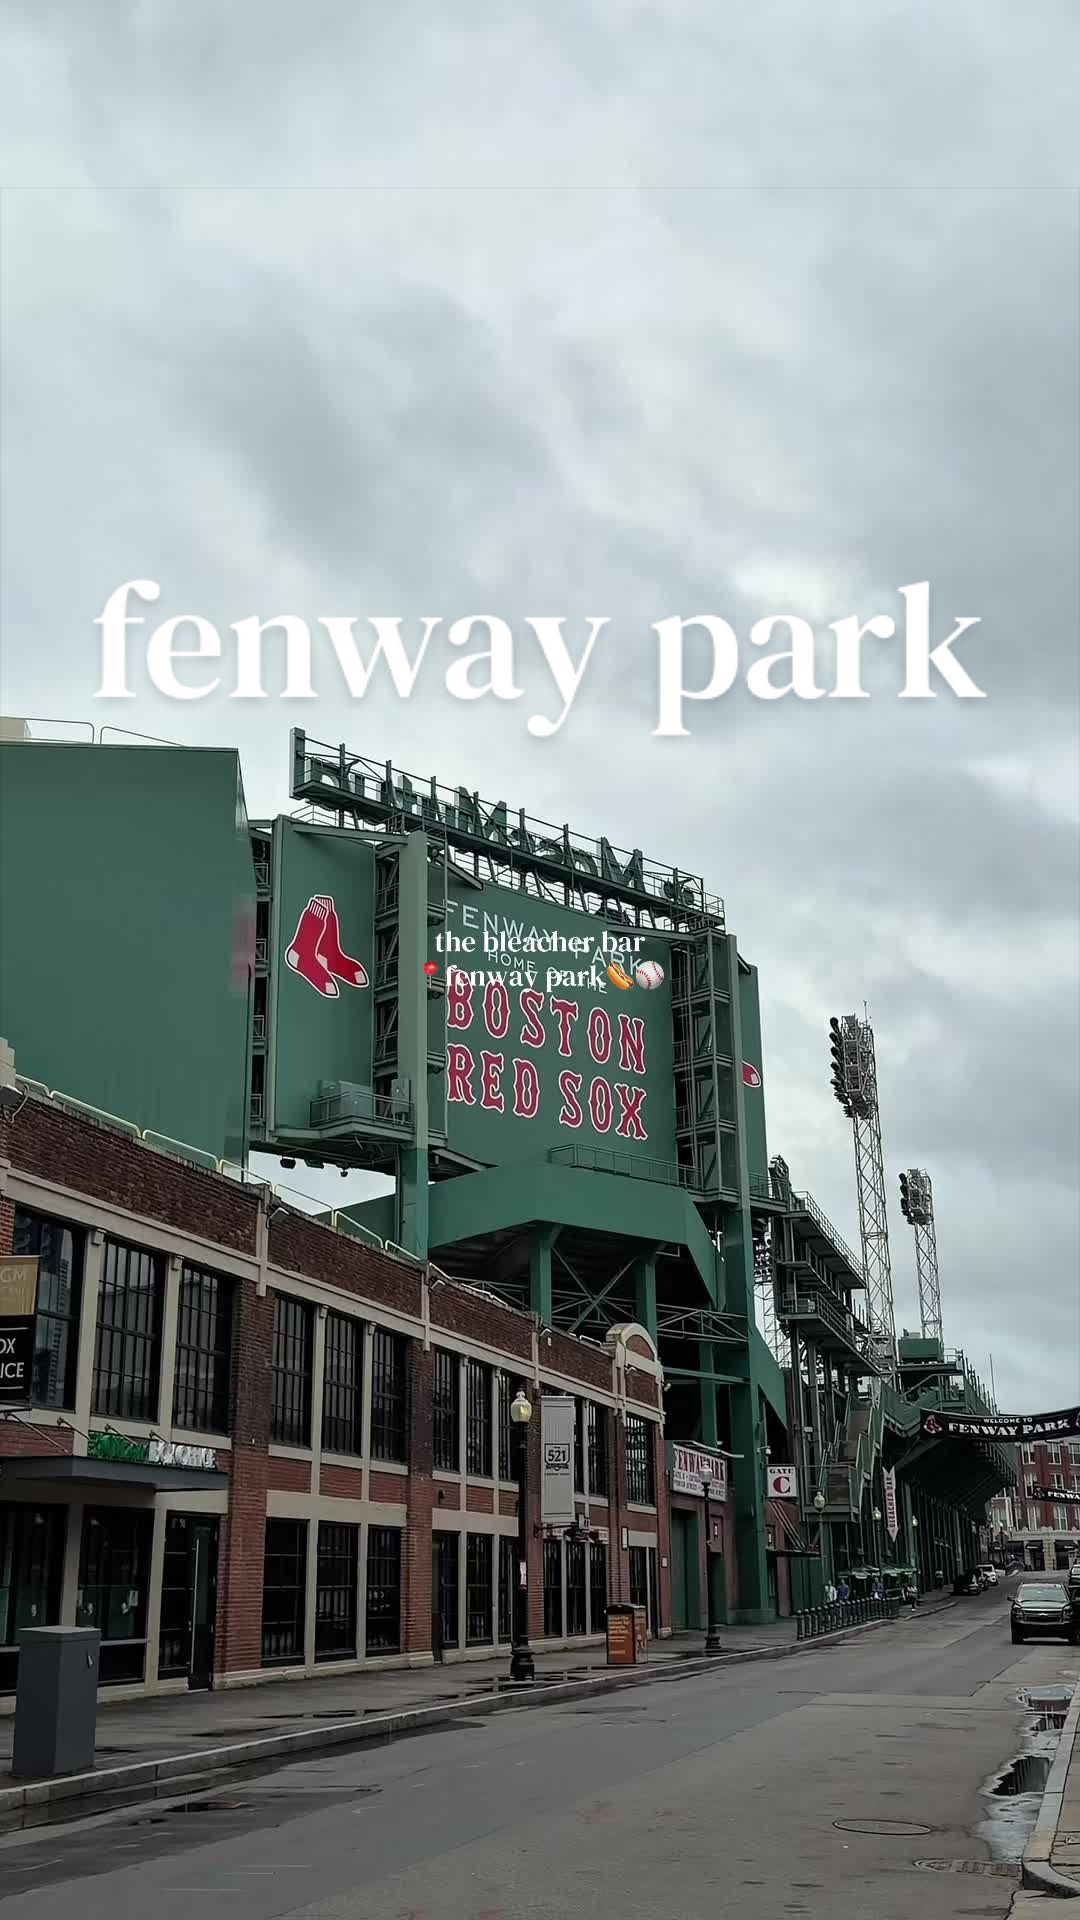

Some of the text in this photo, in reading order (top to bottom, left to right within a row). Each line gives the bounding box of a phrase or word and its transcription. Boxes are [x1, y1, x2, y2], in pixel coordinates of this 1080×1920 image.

[445, 899, 555, 951] FENWAY
[488, 950, 536, 974] HOME
[446, 967, 646, 1074] BOSTON
[447, 1043, 648, 1141] RED SOX
[948, 1418, 1071, 1436] FENWAY PARK
[548, 1450, 566, 1462] 521
[772, 1476, 791, 1494] C
